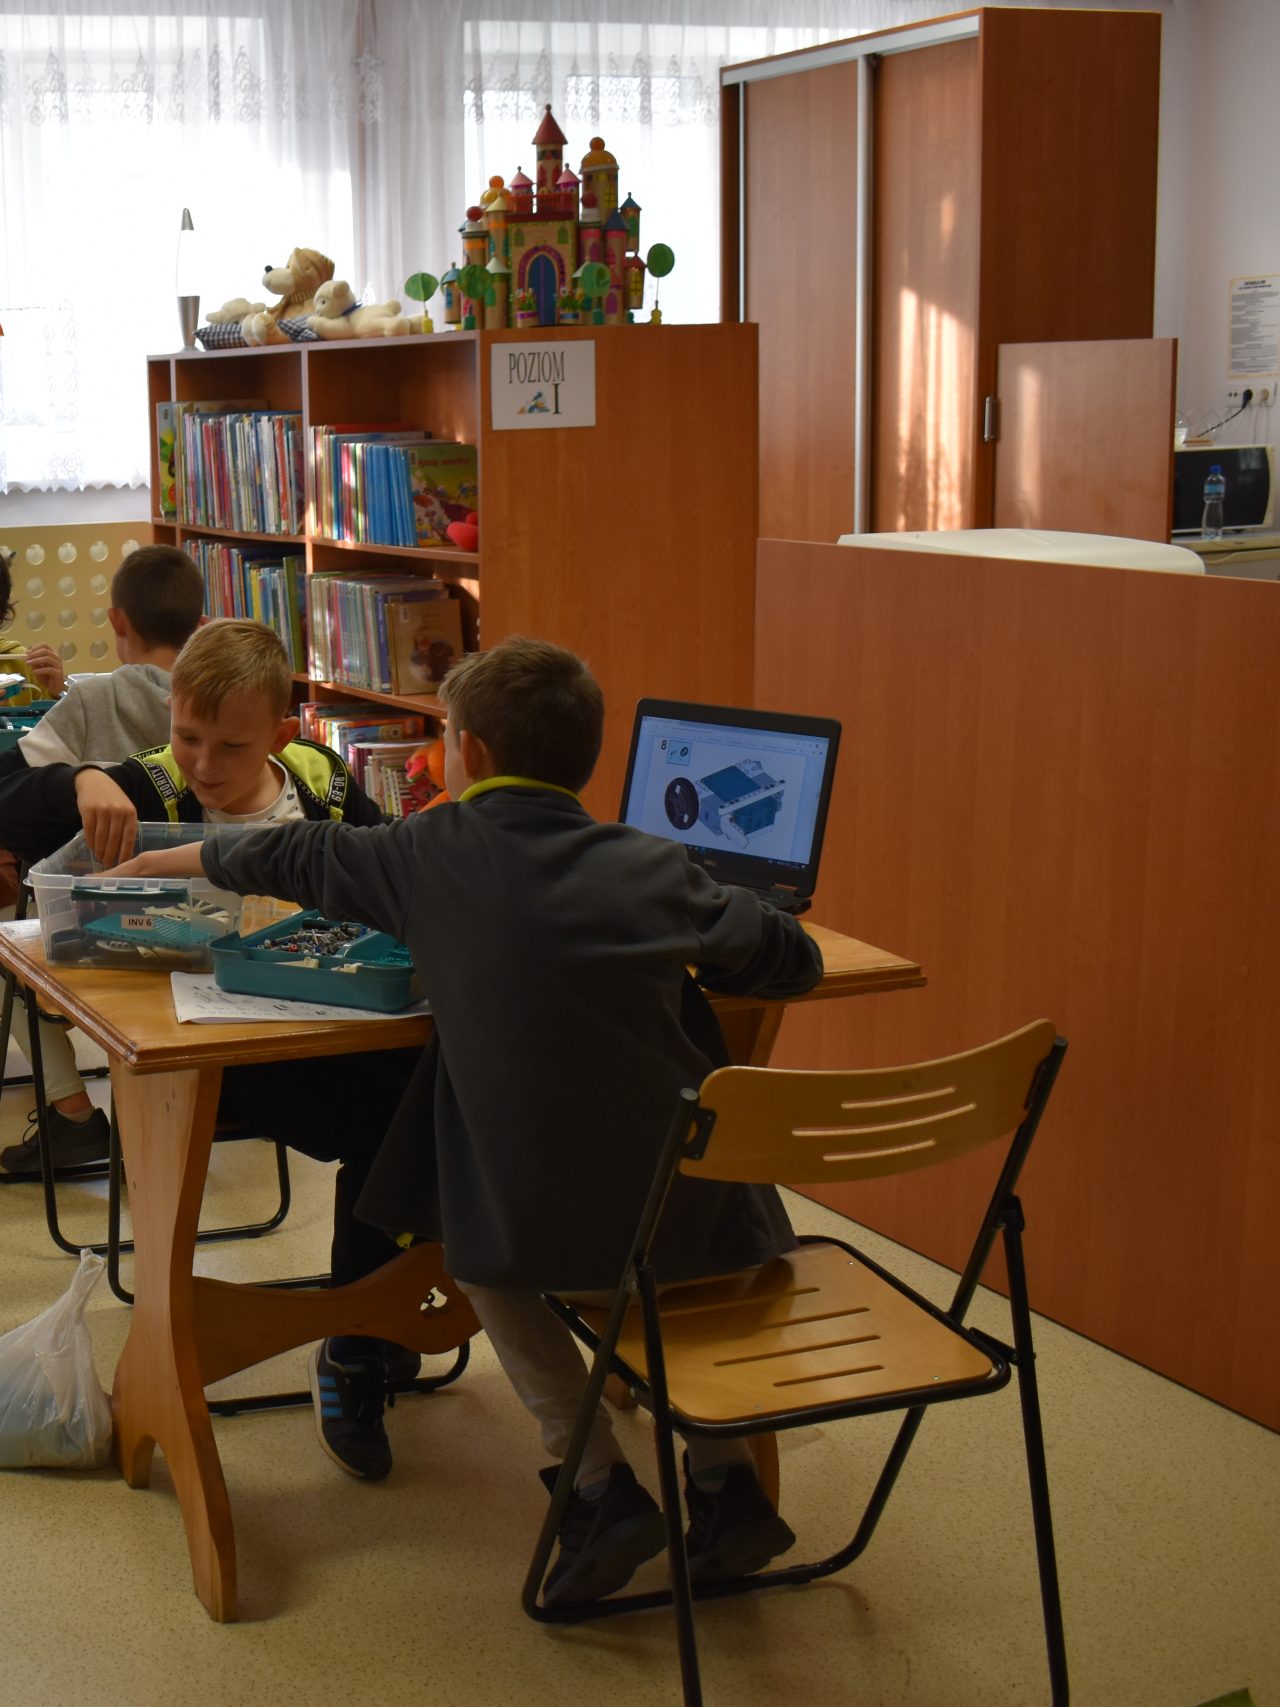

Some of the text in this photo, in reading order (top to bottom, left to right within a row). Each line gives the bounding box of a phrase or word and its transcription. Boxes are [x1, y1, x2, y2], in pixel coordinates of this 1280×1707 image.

[508, 351, 565, 384] POZIOM
[552, 383, 561, 415] I
[661, 739, 668, 751] 8
[128, 918, 152, 927] INV 6
